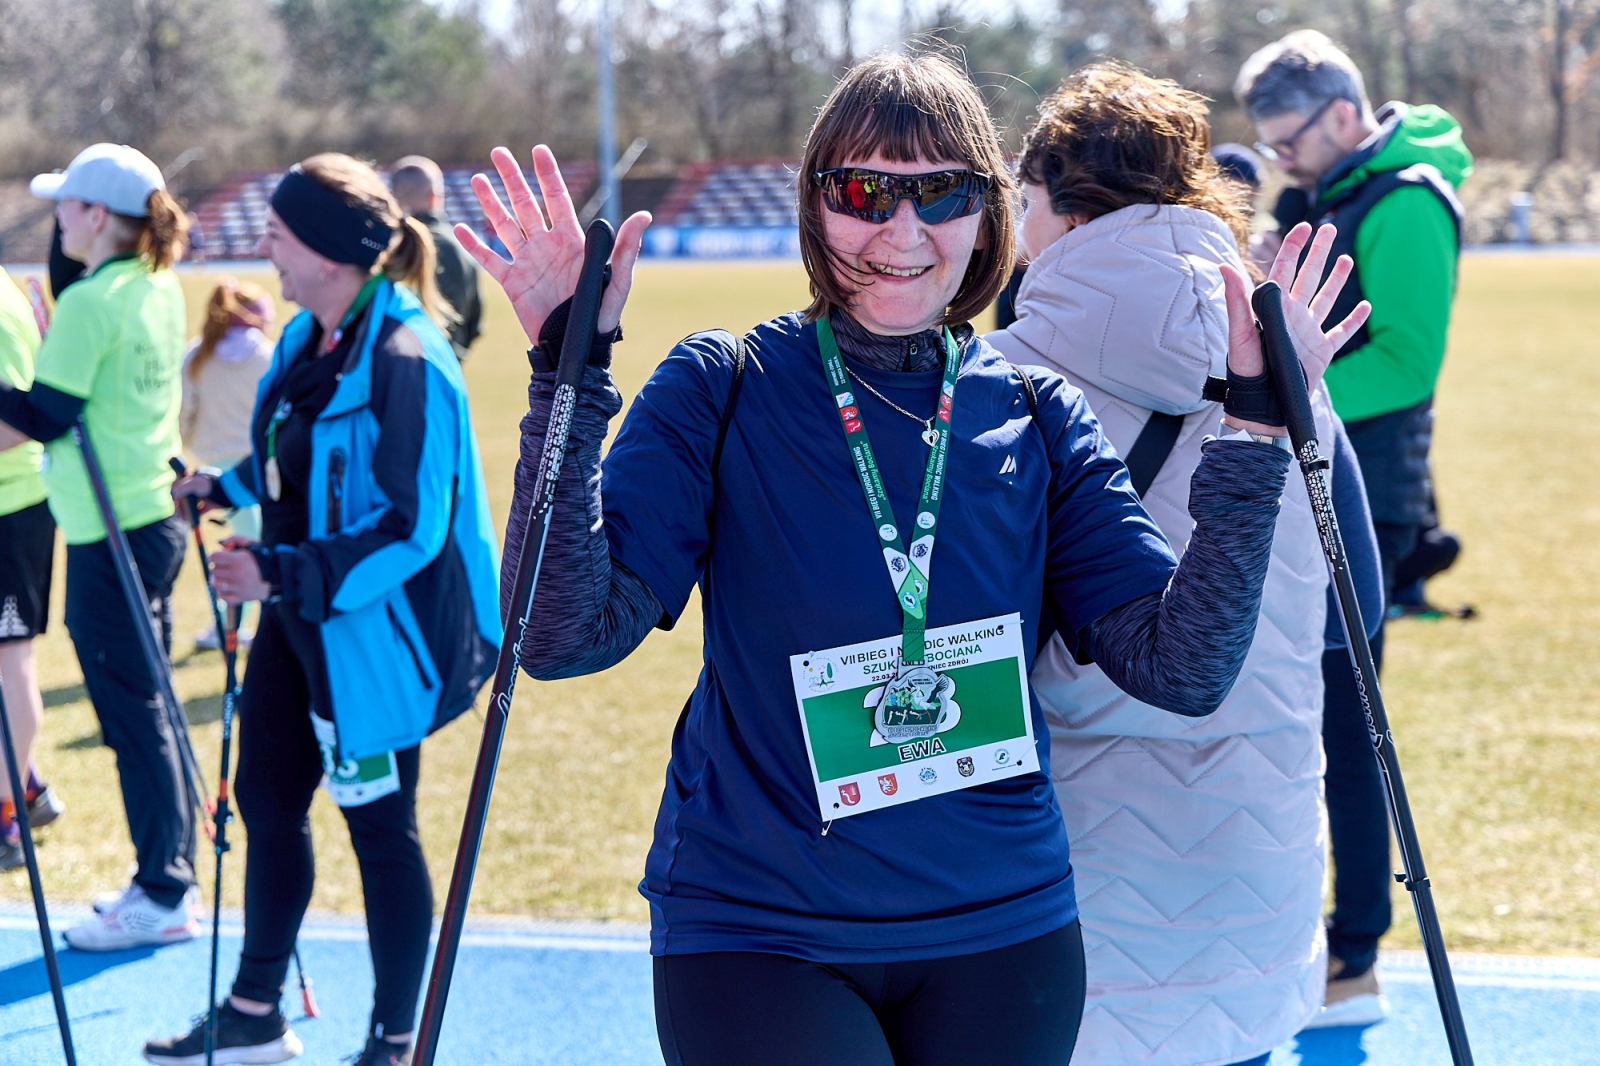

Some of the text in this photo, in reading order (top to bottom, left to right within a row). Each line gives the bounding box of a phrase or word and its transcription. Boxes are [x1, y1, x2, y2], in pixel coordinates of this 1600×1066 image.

[853, 446, 868, 473] WALKING
[935, 452, 944, 475] NORDIC
[861, 471, 875, 495] NORDIC
[930, 474, 942, 501] WALKING
[869, 496, 880, 511] BIEG
[840, 625, 1005, 666] VII BIEG I NDIC WALKING
[927, 644, 983, 663] BOCIANA
[947, 658, 969, 667] ZDRÓJ
[899, 738, 946, 762] EWA
